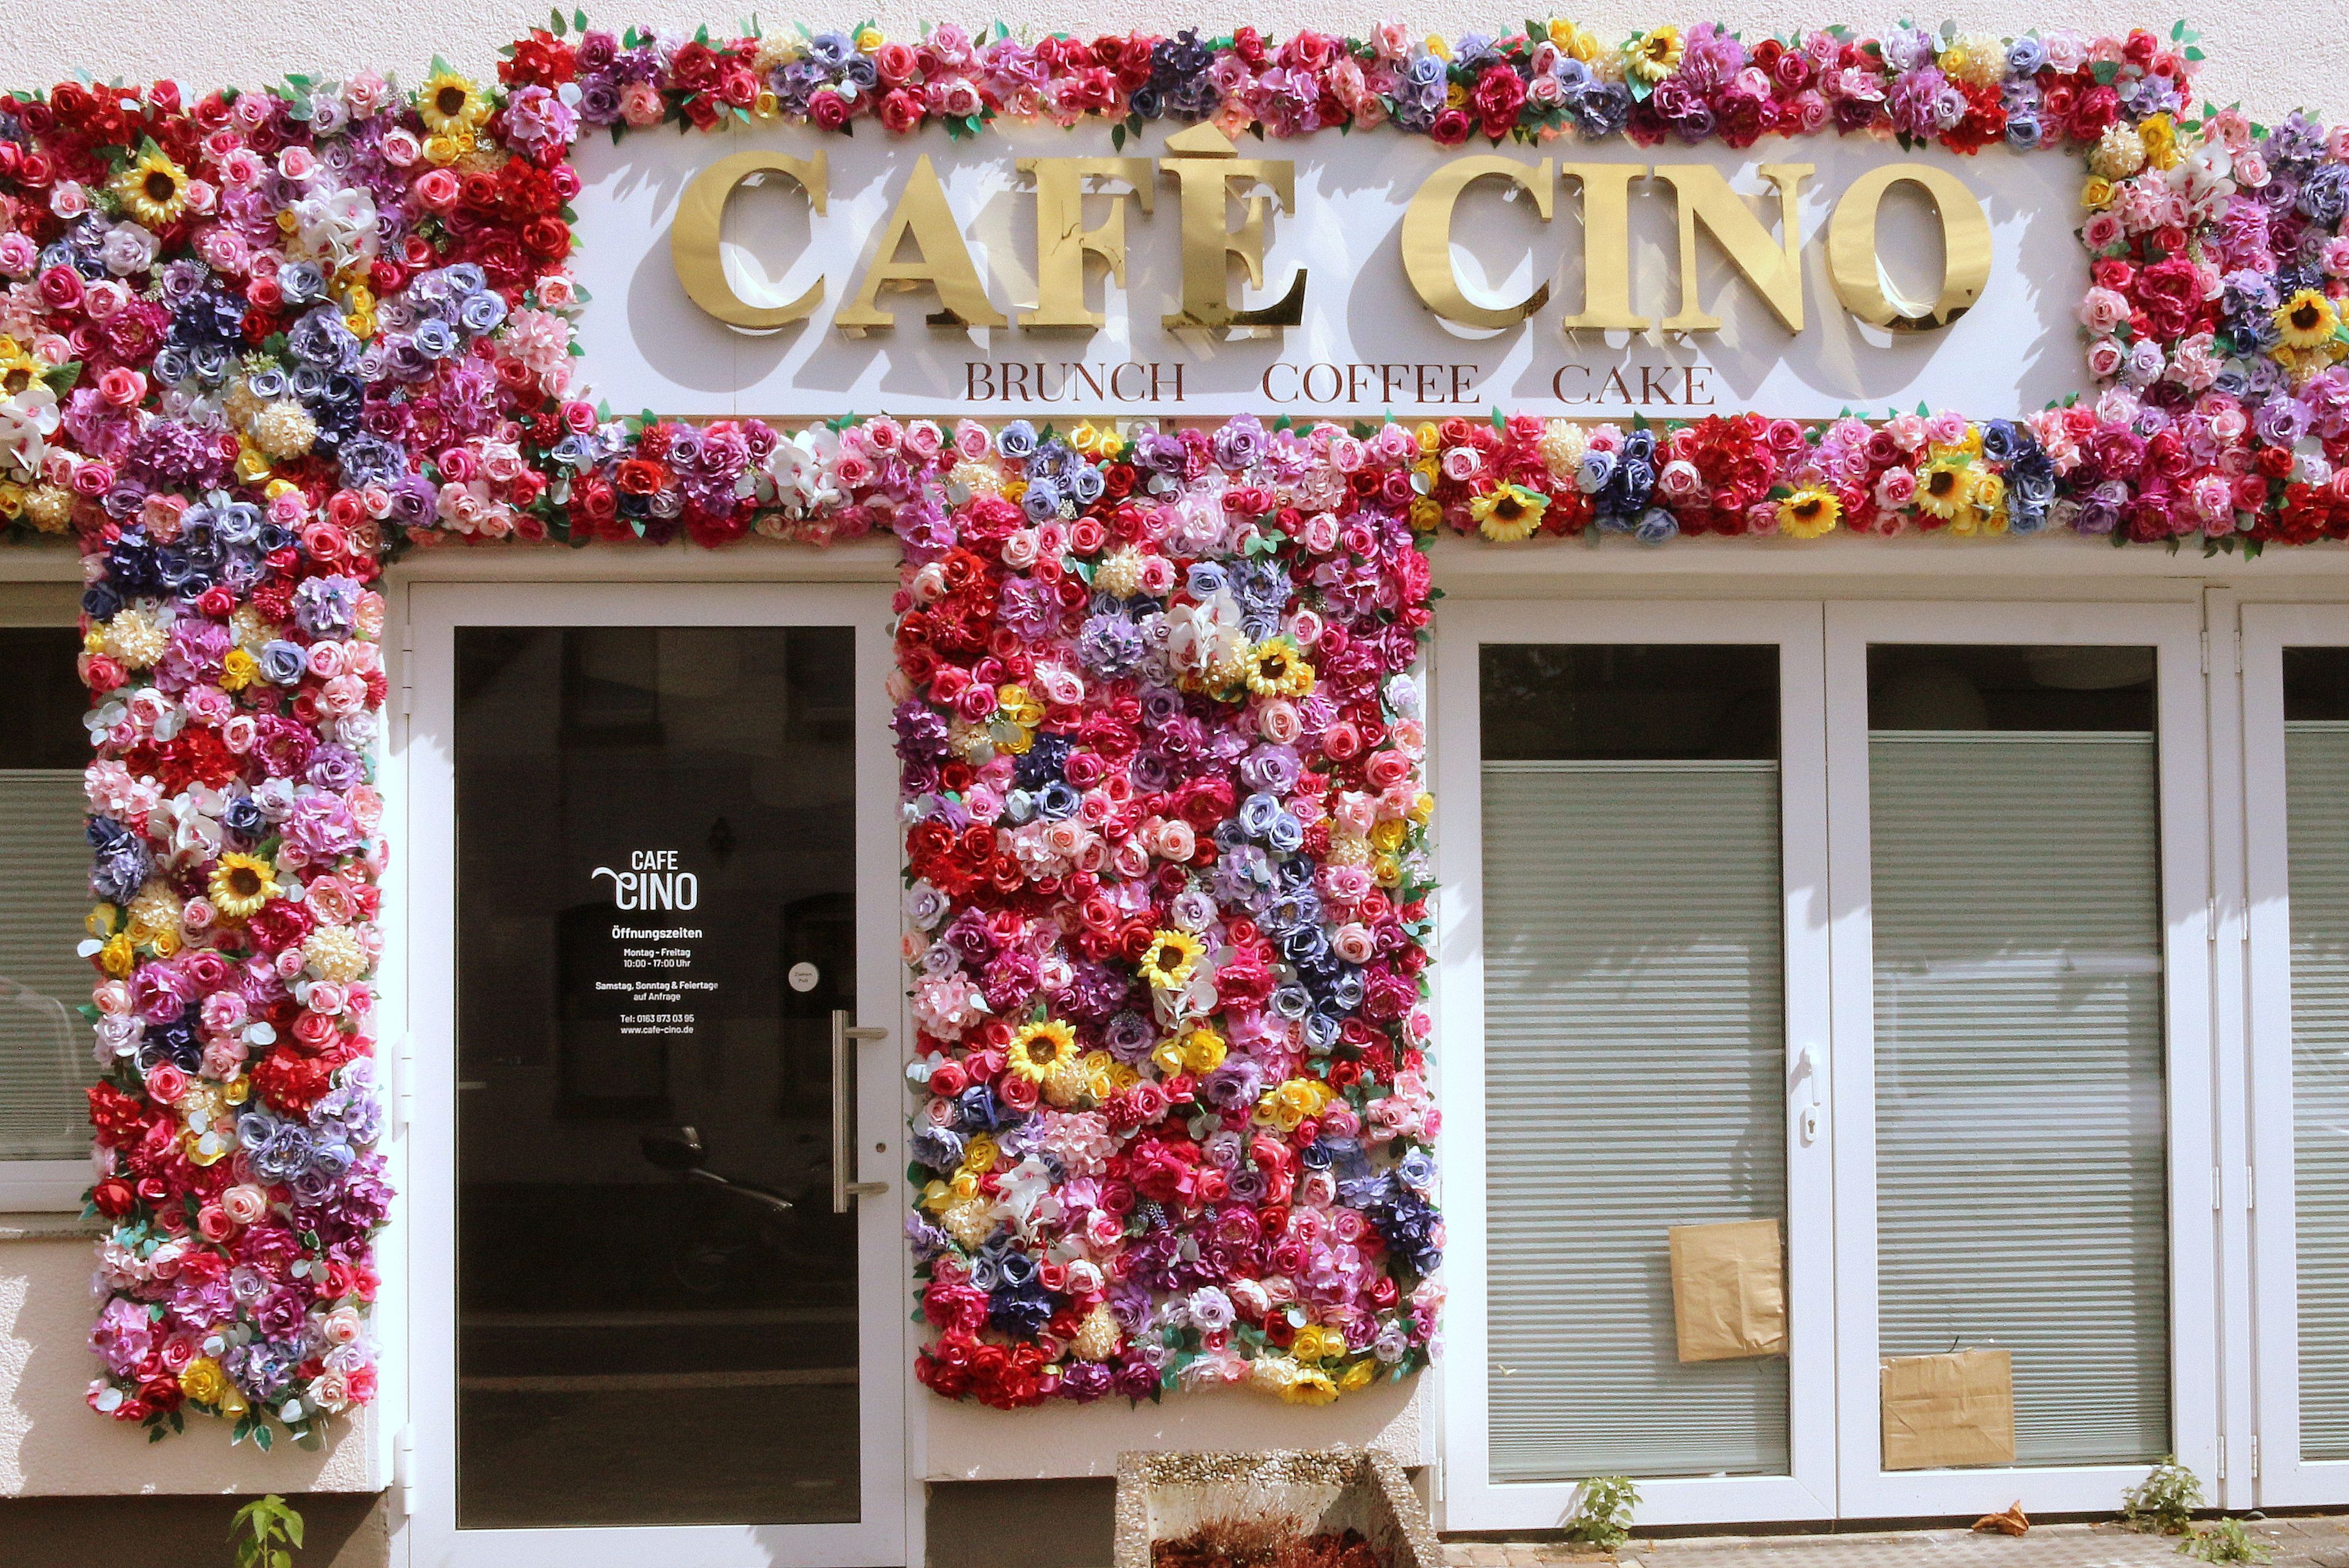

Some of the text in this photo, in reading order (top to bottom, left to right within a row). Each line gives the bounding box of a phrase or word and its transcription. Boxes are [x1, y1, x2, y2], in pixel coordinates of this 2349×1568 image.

[1401, 154, 1993, 335] CINO
[965, 362, 1716, 406] BRUNCH COFFEE CAKE
[631, 850, 678, 870] CAFE
[591, 866, 698, 911] CINO
[611, 924, 703, 941] Öffnungszeiten
[624, 948, 655, 958] Montag
[661, 948, 691, 958] Freitag
[624, 959, 647, 968] 10:00
[653, 959, 675, 968] 17:00
[676, 960, 691, 968] Uhr
[595, 981, 719, 991] Samstag, Sonntag & Feiertage
[633, 992, 681, 1002] auf Anfrage
[620, 1014, 635, 1023] Tel:
[620, 1025, 694, 1034] www.cafe-cino.de
